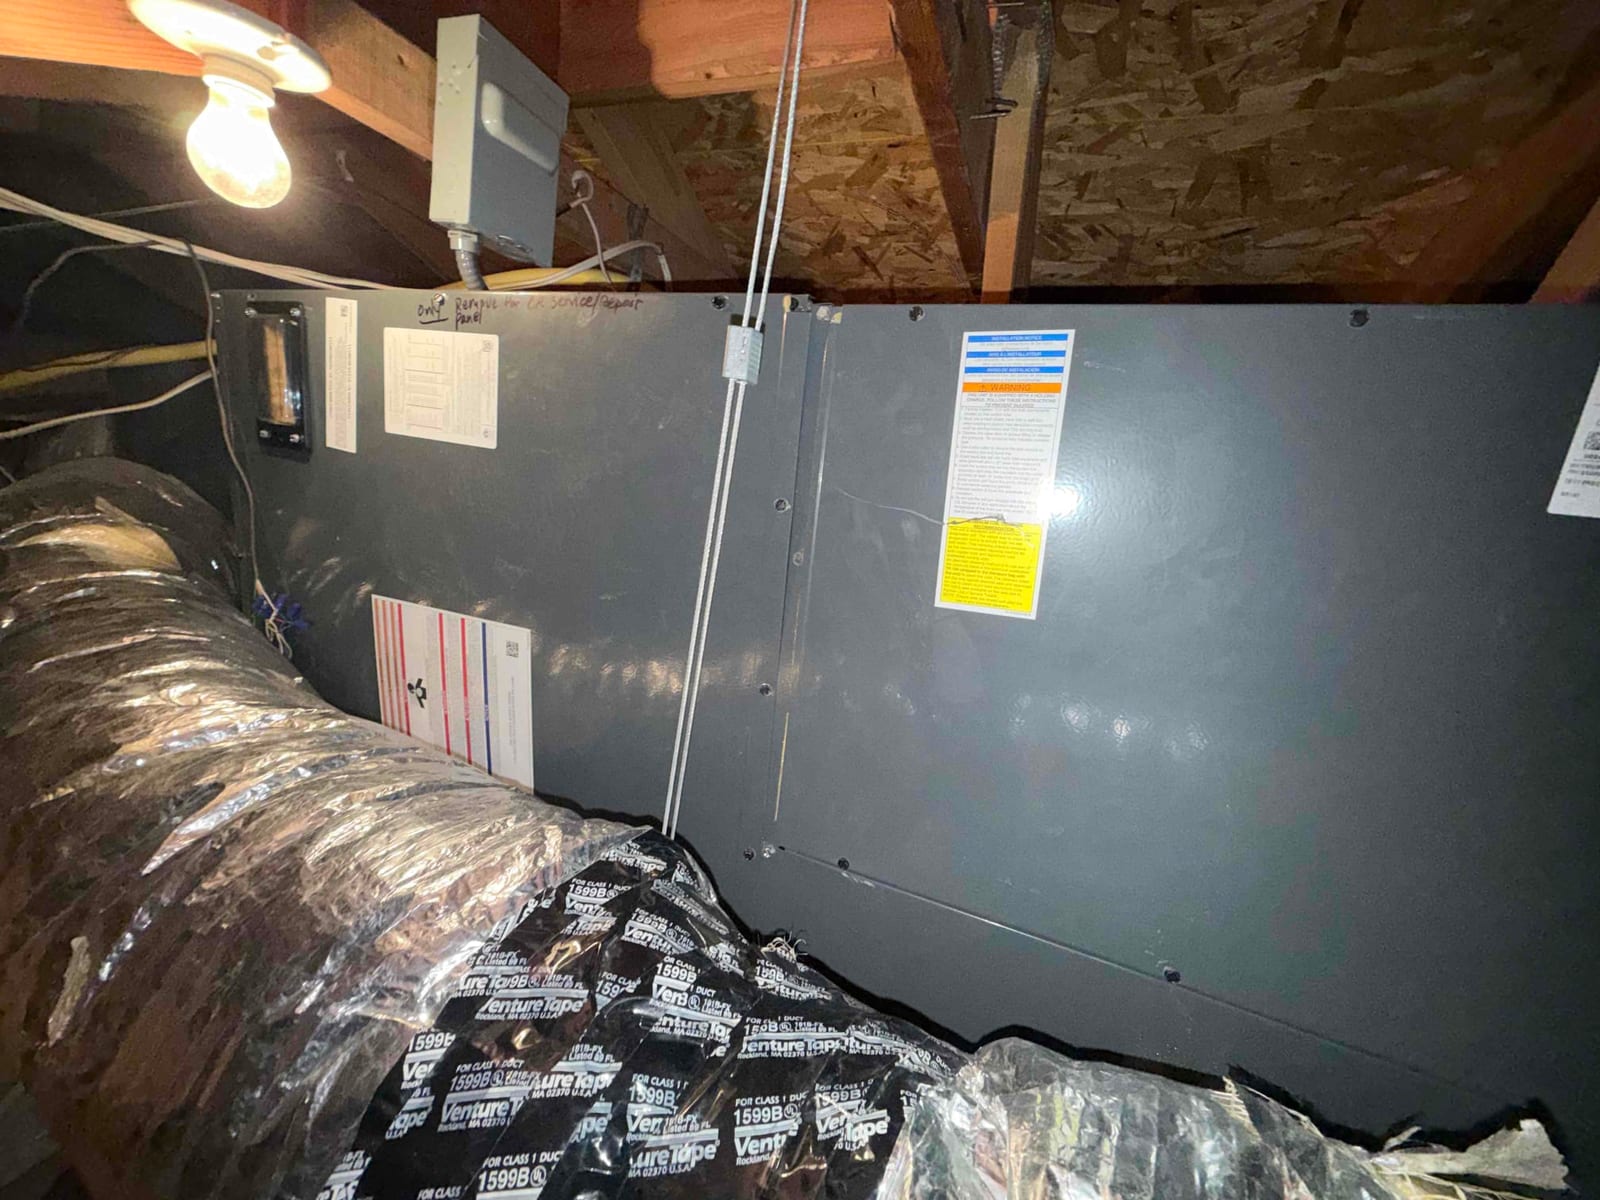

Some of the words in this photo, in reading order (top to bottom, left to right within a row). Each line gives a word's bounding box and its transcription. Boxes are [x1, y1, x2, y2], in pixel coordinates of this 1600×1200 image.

[568, 884, 607, 898] 1599B
[601, 972, 617, 981] FOR
[656, 963, 697, 983] 1599B
[696, 986, 716, 997] DUCT
[456, 1063, 471, 1073] FOR
[472, 1061, 493, 1071] CLASS
[450, 1071, 491, 1091] 1599B
[632, 1073, 649, 1083] FOR
[651, 1077, 674, 1088] CLASS
[629, 1084, 676, 1107] 1599B
[735, 1098, 753, 1107] FOR
[755, 1095, 780, 1106] CLASS
[734, 1105, 783, 1126] 1599B
[482, 1156, 501, 1169] FOR
[502, 1154, 530, 1166] CLASS
[531, 1153, 536, 1164] 1
[478, 1166, 530, 1192] 1599B
[417, 1188, 433, 1200] FOR
[434, 1186, 461, 1199] CLASS
